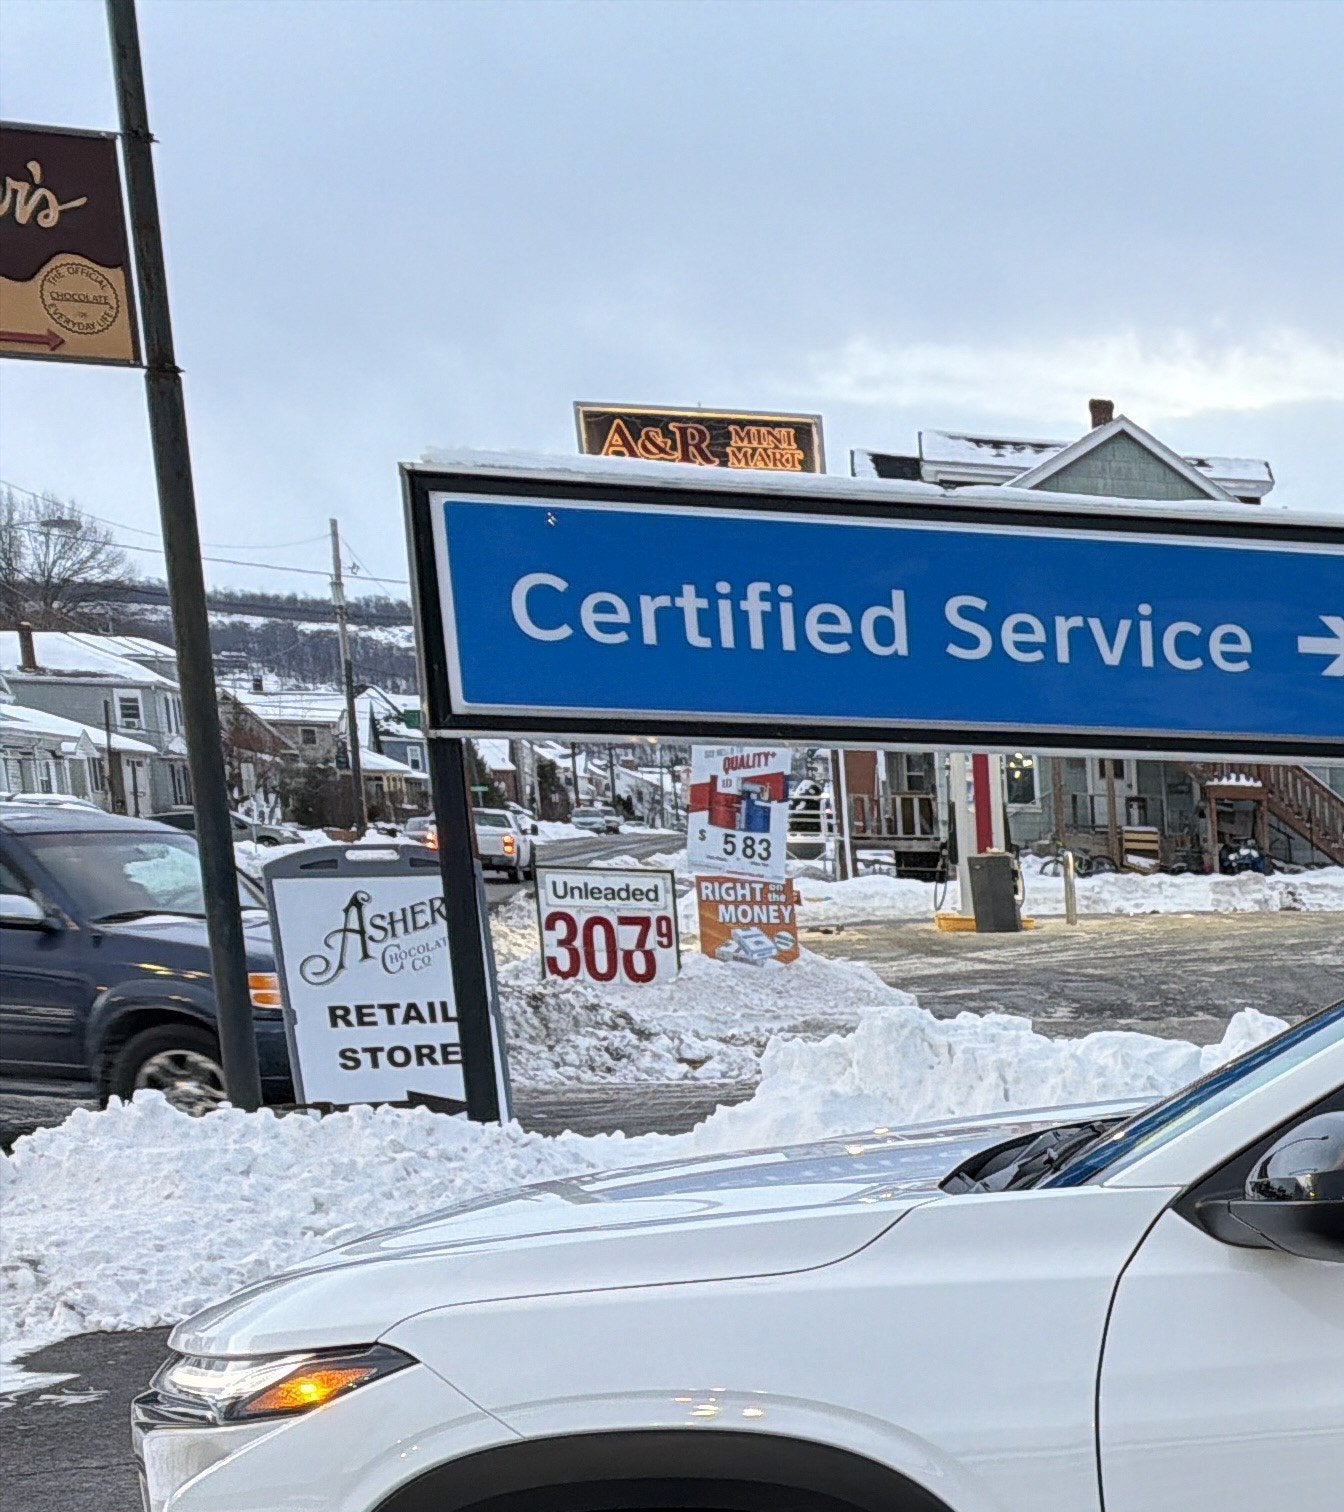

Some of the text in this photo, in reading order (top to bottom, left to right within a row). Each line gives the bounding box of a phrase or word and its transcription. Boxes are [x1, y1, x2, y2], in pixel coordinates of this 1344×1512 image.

[47, 266, 108, 290] THE OFFICIAL
[50, 291, 108, 303] CHOCOLATE
[48, 303, 96, 330] EVERYDAY
[601, 418, 796, 467] A&R MINI
[726, 446, 804, 470] MART
[510, 571, 1253, 674] Certified Service
[698, 829, 707, 841] $
[551, 880, 659, 903] Unleaded
[701, 881, 763, 902] RIGHT
[768, 892, 786, 902] the
[718, 904, 792, 924] MONEY
[300, 890, 448, 985] ASHER
[382, 937, 448, 974] CHOCOLAT
[328, 1001, 458, 1028] RETAIL
[338, 1043, 462, 1071] STORE
